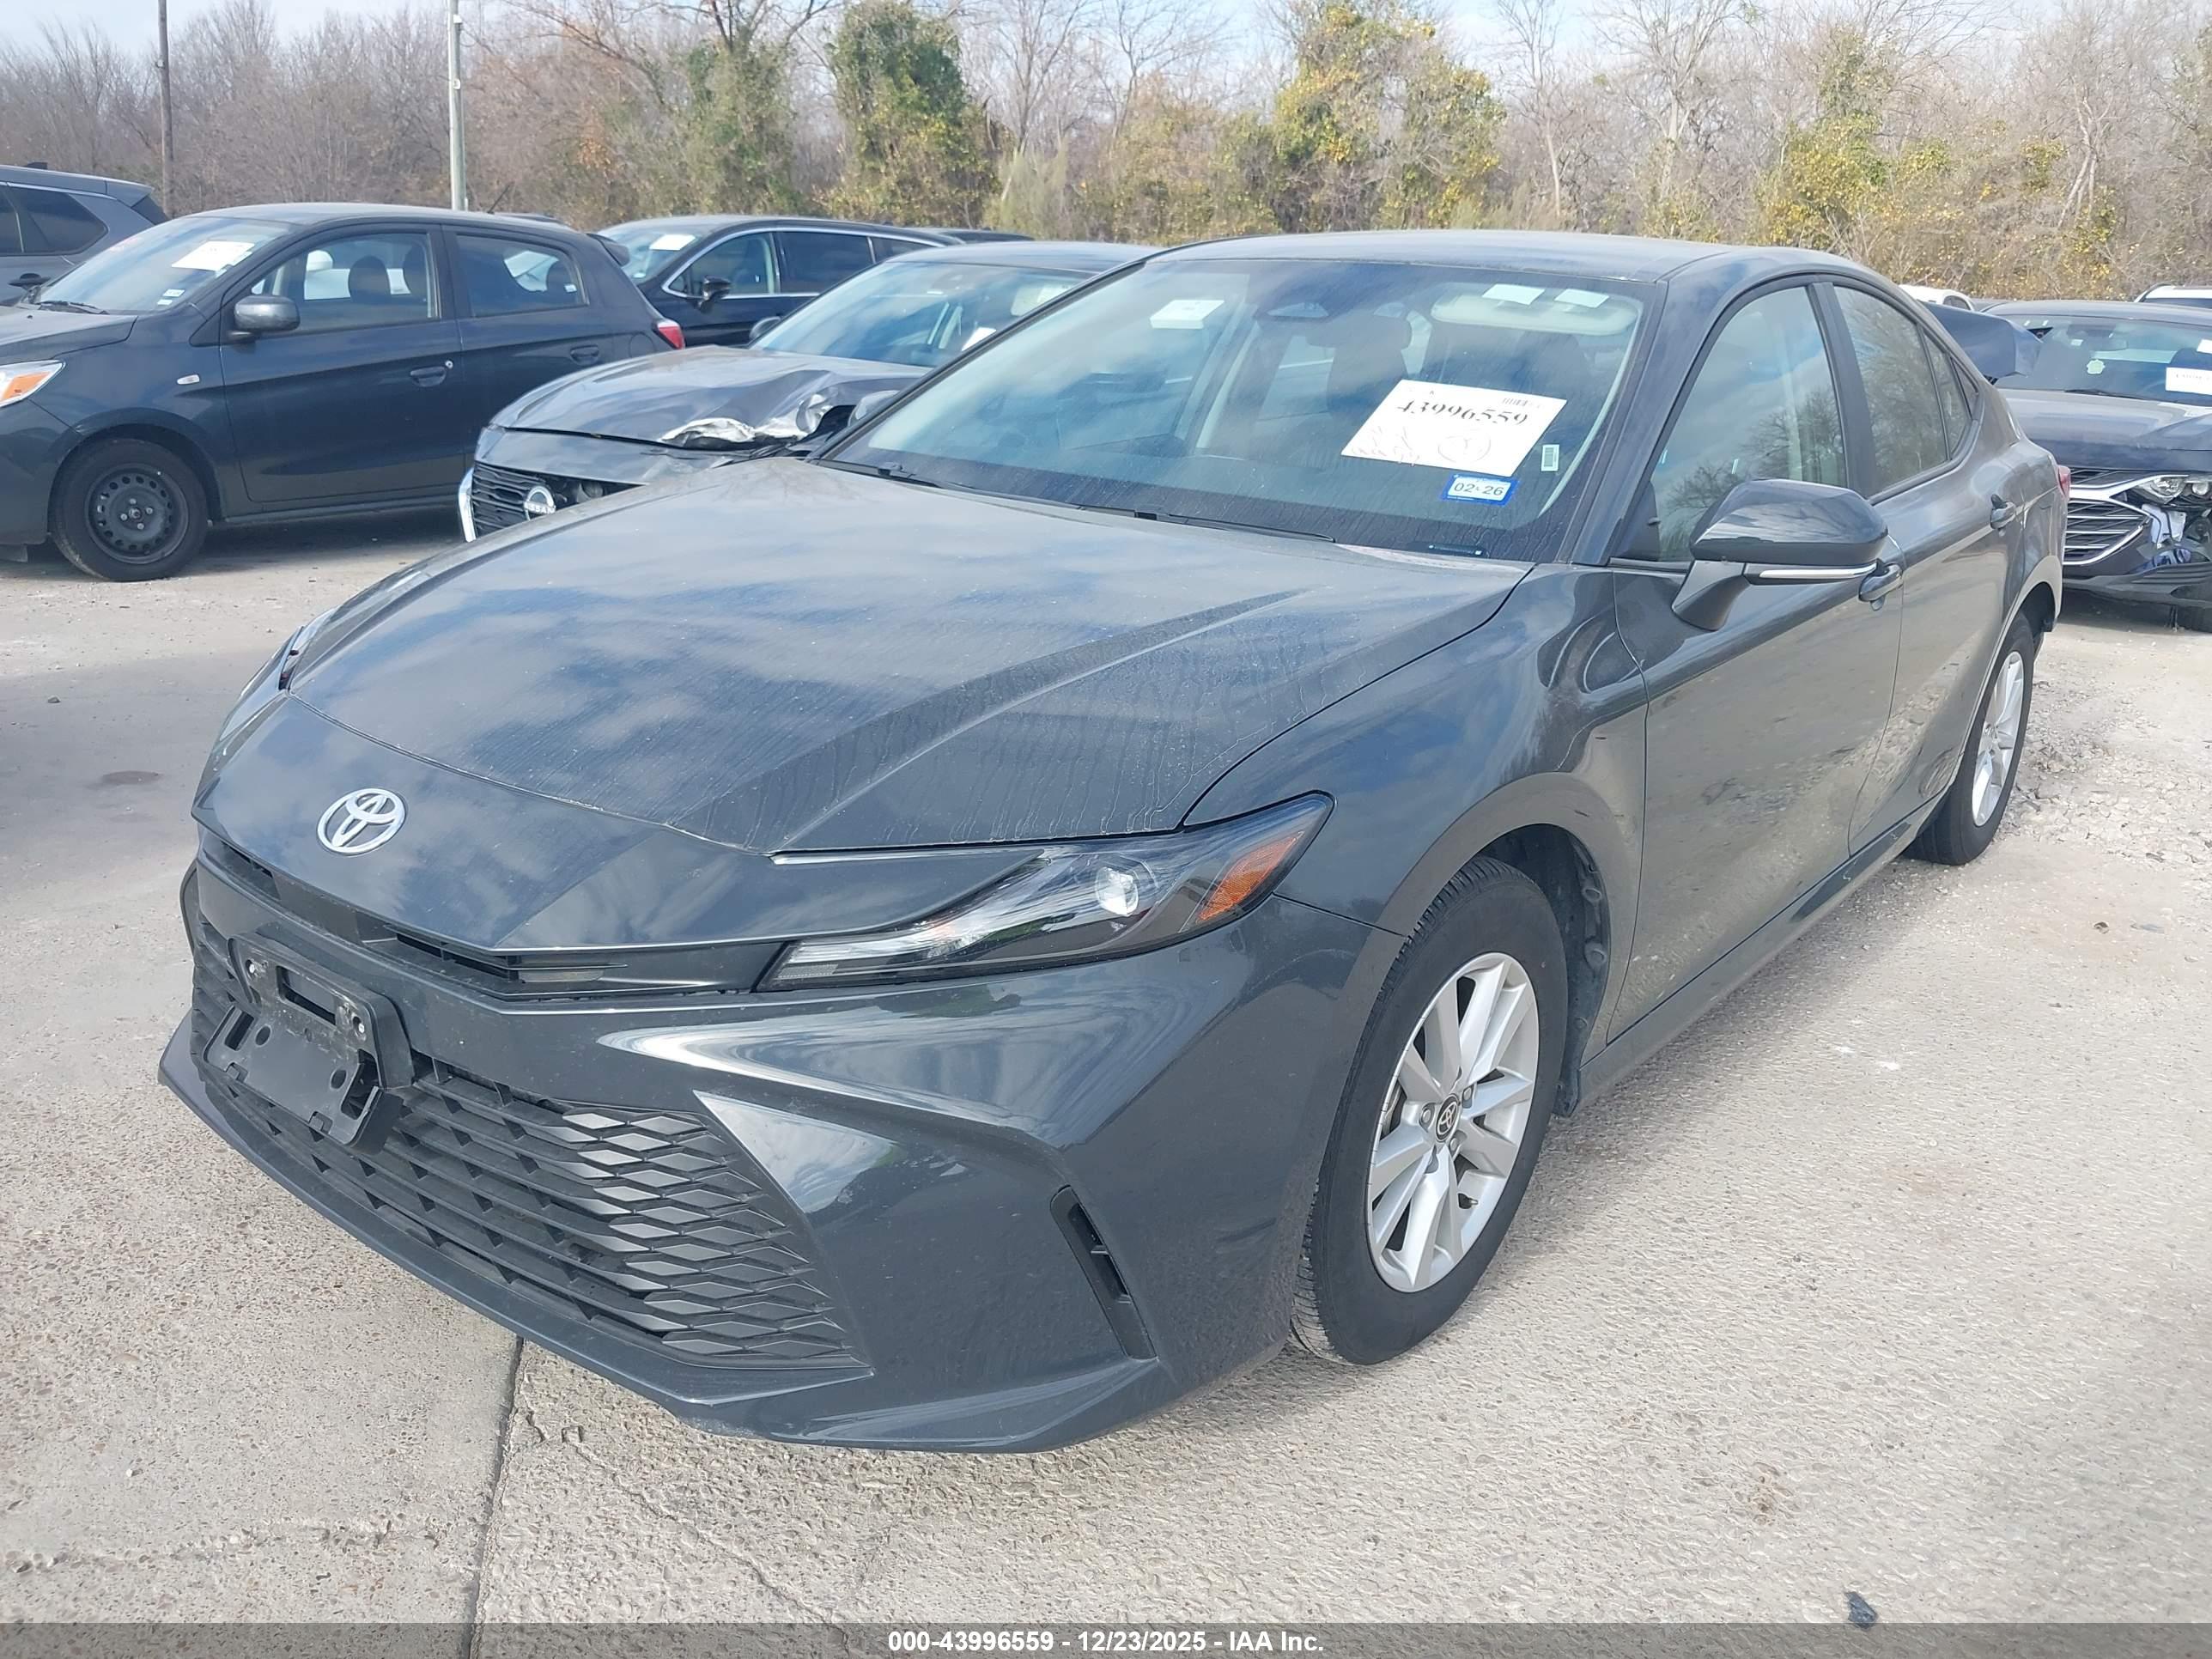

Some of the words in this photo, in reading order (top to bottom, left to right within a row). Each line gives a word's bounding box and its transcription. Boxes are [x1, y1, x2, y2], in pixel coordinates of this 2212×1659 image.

[1397, 400, 1528, 425] 43996559
[1454, 483, 1475, 493] 02
[1482, 485, 1504, 495] 26
